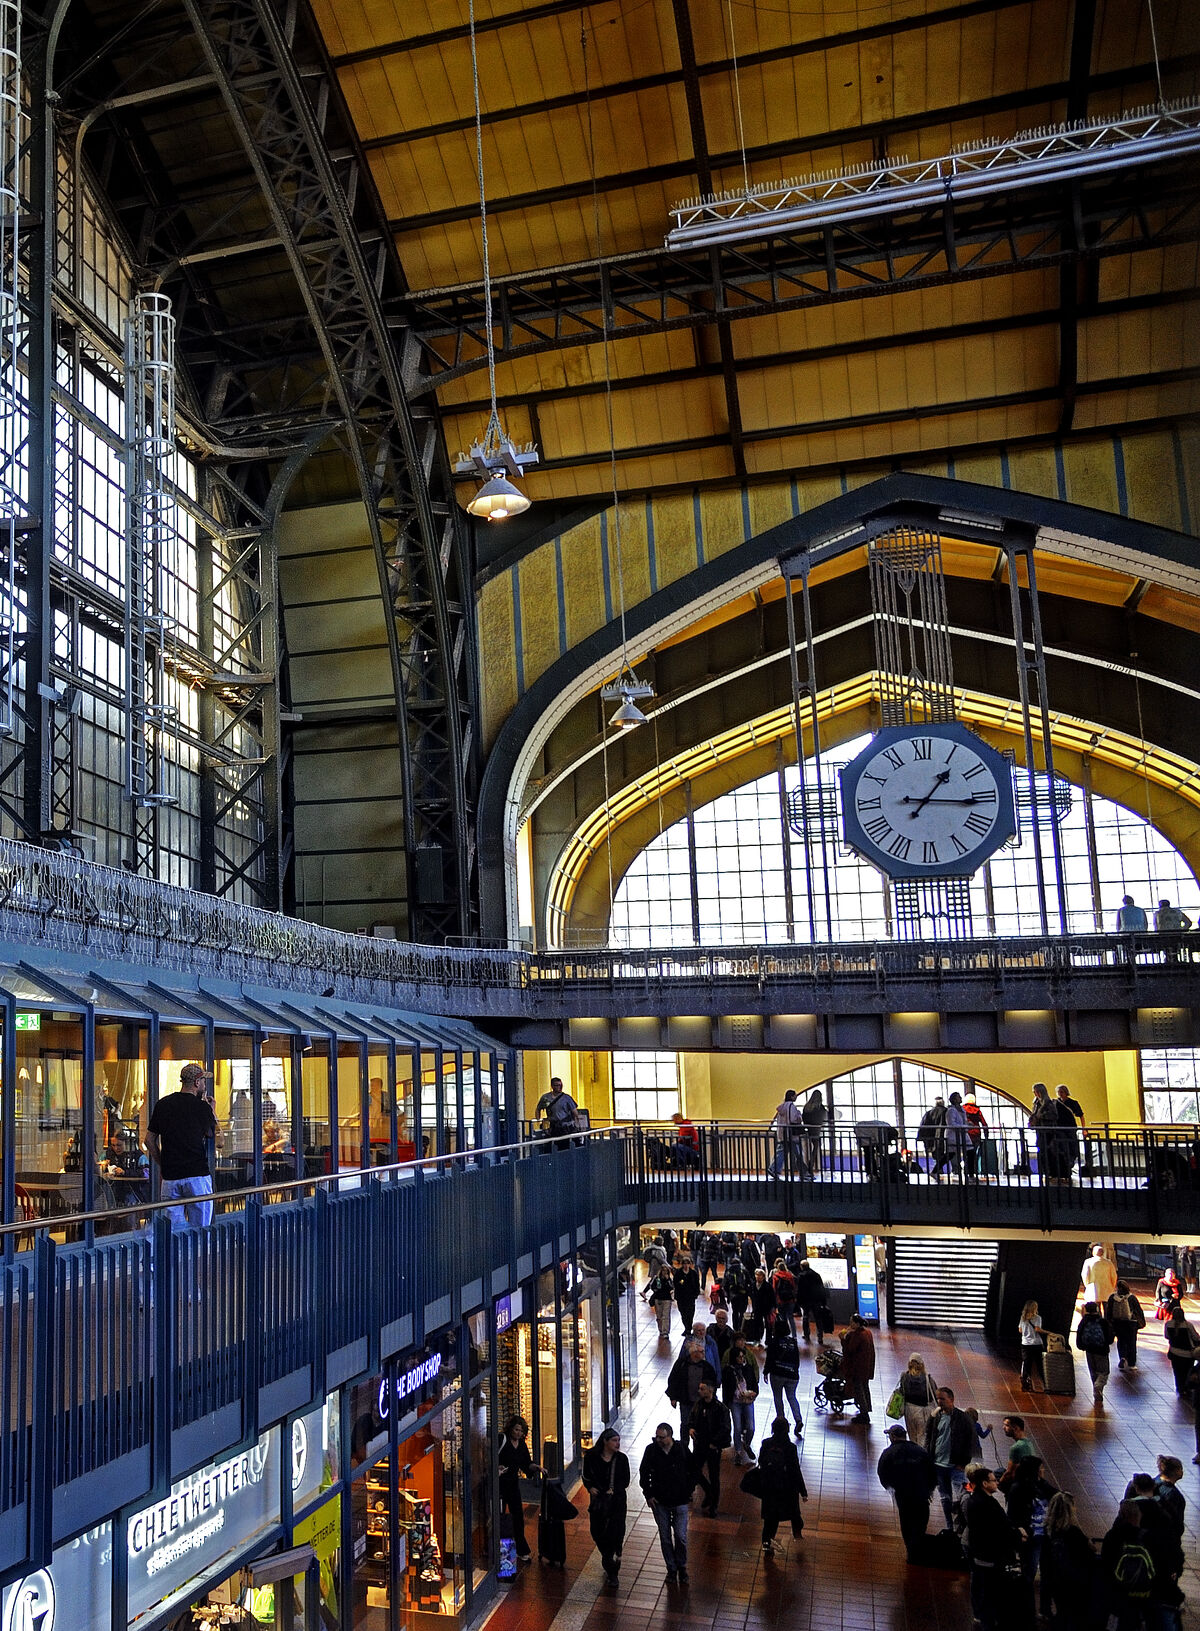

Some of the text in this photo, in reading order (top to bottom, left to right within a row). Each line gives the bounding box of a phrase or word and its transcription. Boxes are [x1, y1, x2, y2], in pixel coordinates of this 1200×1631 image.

[882, 748, 905, 770] XI
[911, 739, 933, 761] XII
[945, 745, 958, 764] I
[863, 772, 888, 787] X
[961, 762, 986, 781] II
[858, 797, 881, 811] IX
[864, 816, 893, 845] VIII
[887, 834, 912, 861] VII
[921, 842, 939, 863] VI
[949, 835, 969, 856] V
[406, 1363, 425, 1394] BODY
[424, 1353, 441, 1382] SHOP
[132, 1457, 249, 1553] CHIETWETTER
